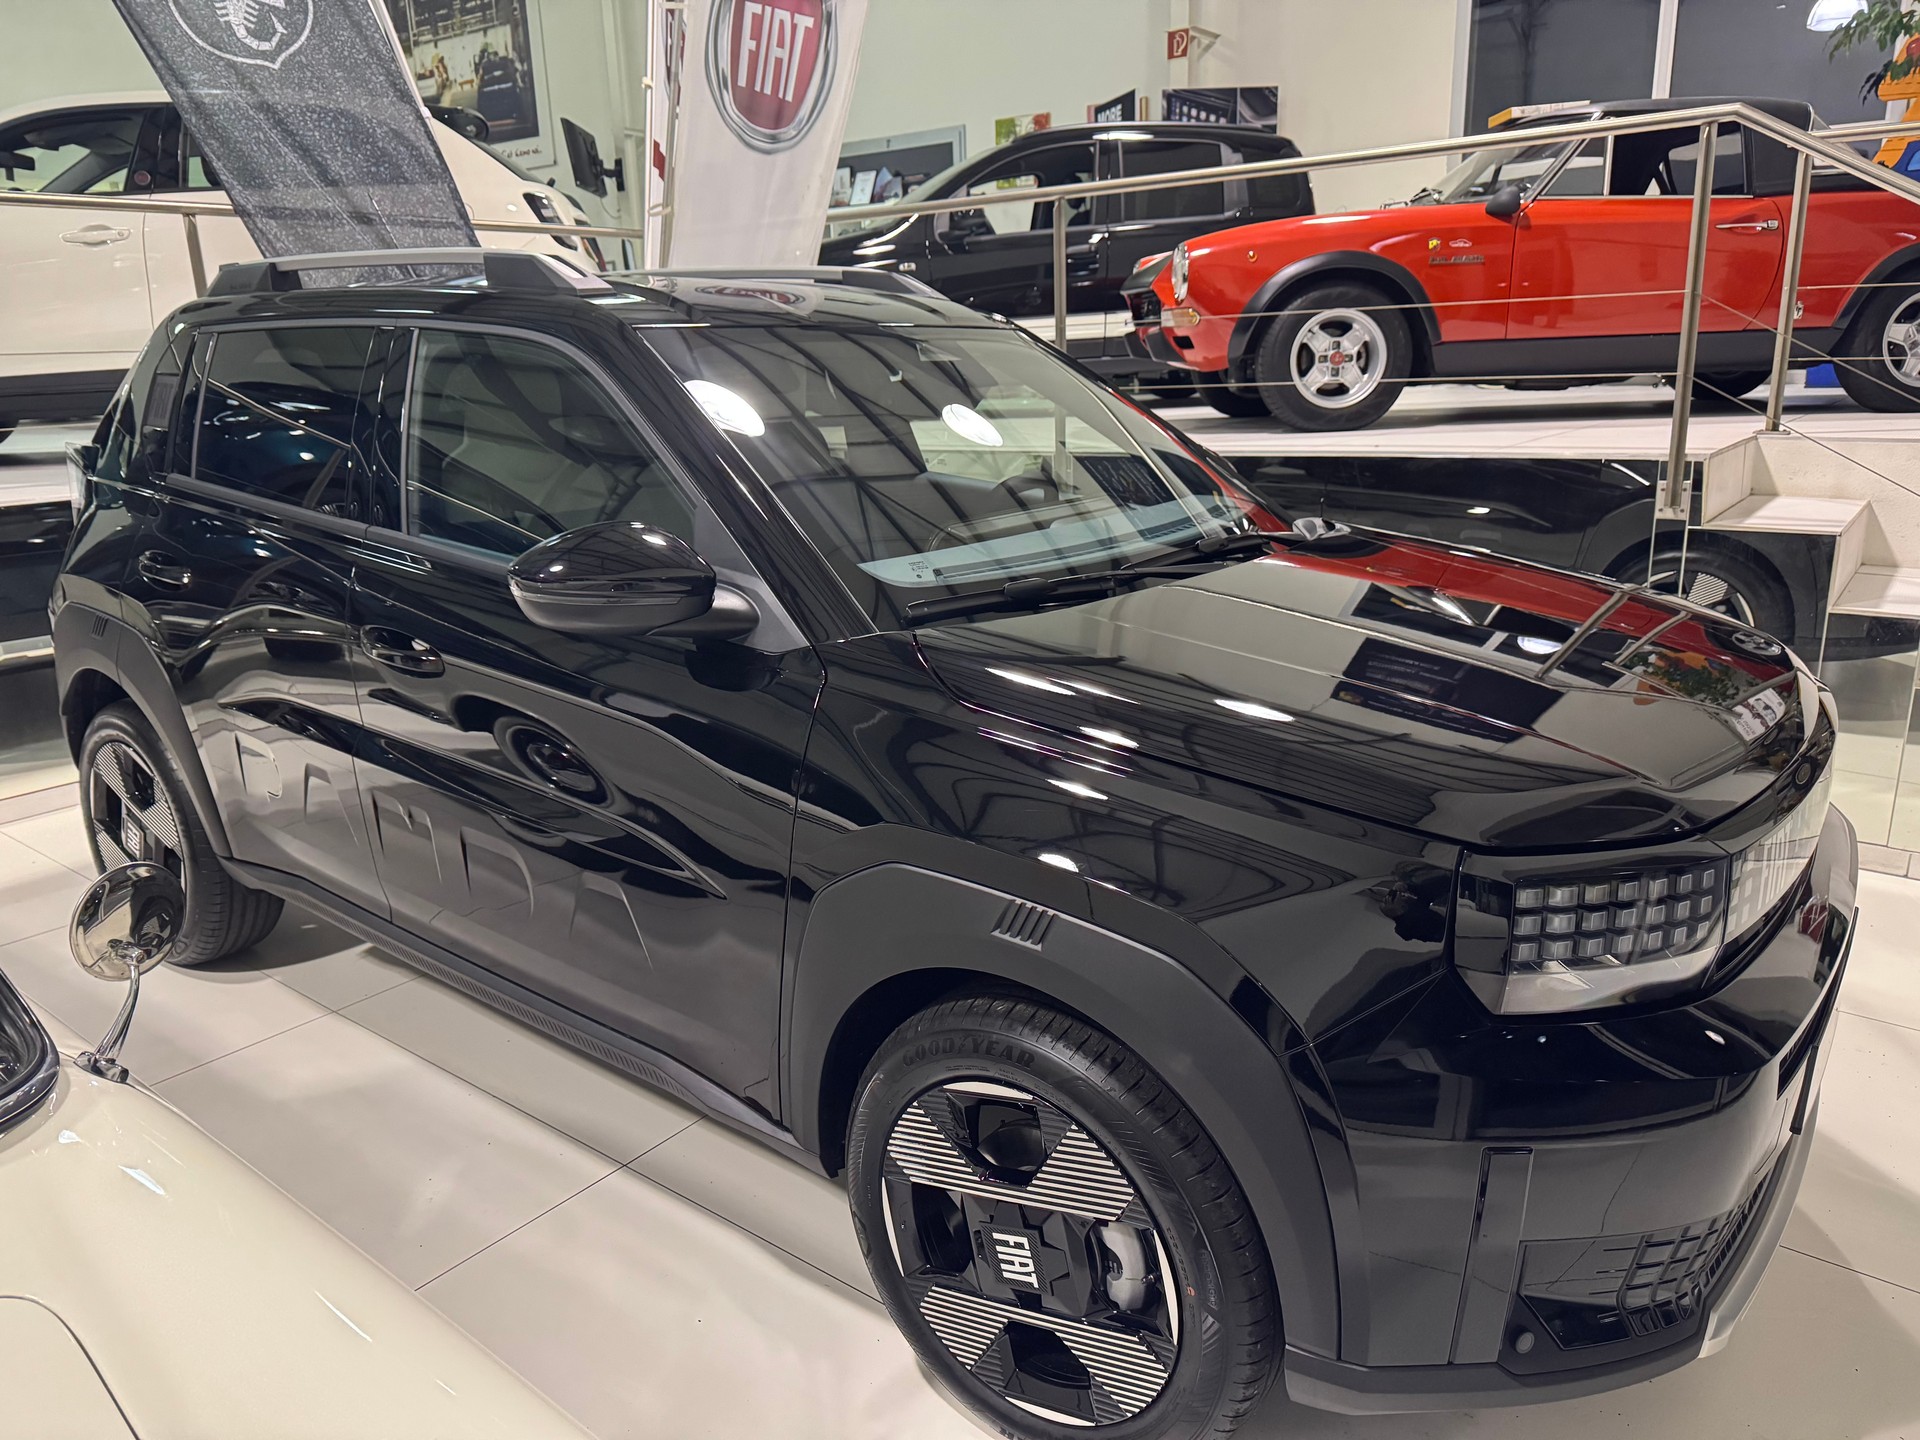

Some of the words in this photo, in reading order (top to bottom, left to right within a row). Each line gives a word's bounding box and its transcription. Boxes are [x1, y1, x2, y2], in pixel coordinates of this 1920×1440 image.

[737, 1, 815, 103] FIAT
[1097, 103, 1122, 122] MORE
[126, 821, 140, 859] FIAT
[234, 730, 655, 972] PANDA
[902, 1036, 1036, 1069] GOODYEAR
[991, 1232, 1039, 1289] FIAT
